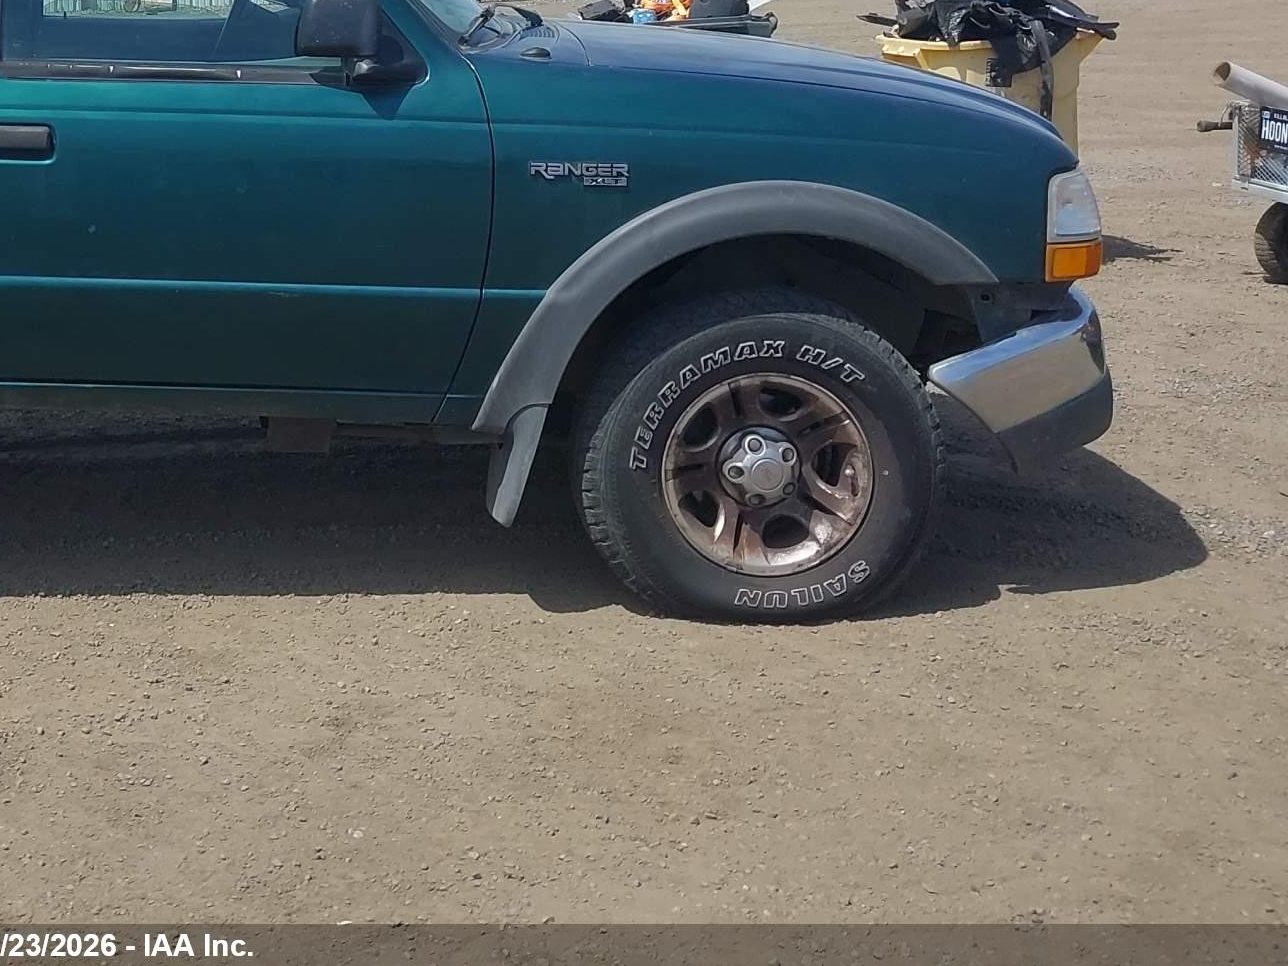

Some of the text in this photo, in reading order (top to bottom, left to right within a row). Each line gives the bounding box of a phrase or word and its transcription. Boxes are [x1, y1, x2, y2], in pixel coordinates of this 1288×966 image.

[529, 162, 629, 179] RANGER
[588, 177, 624, 185] XLT
[629, 340, 866, 472] TERRAMAX H/T
[734, 561, 871, 609] SAILUN
